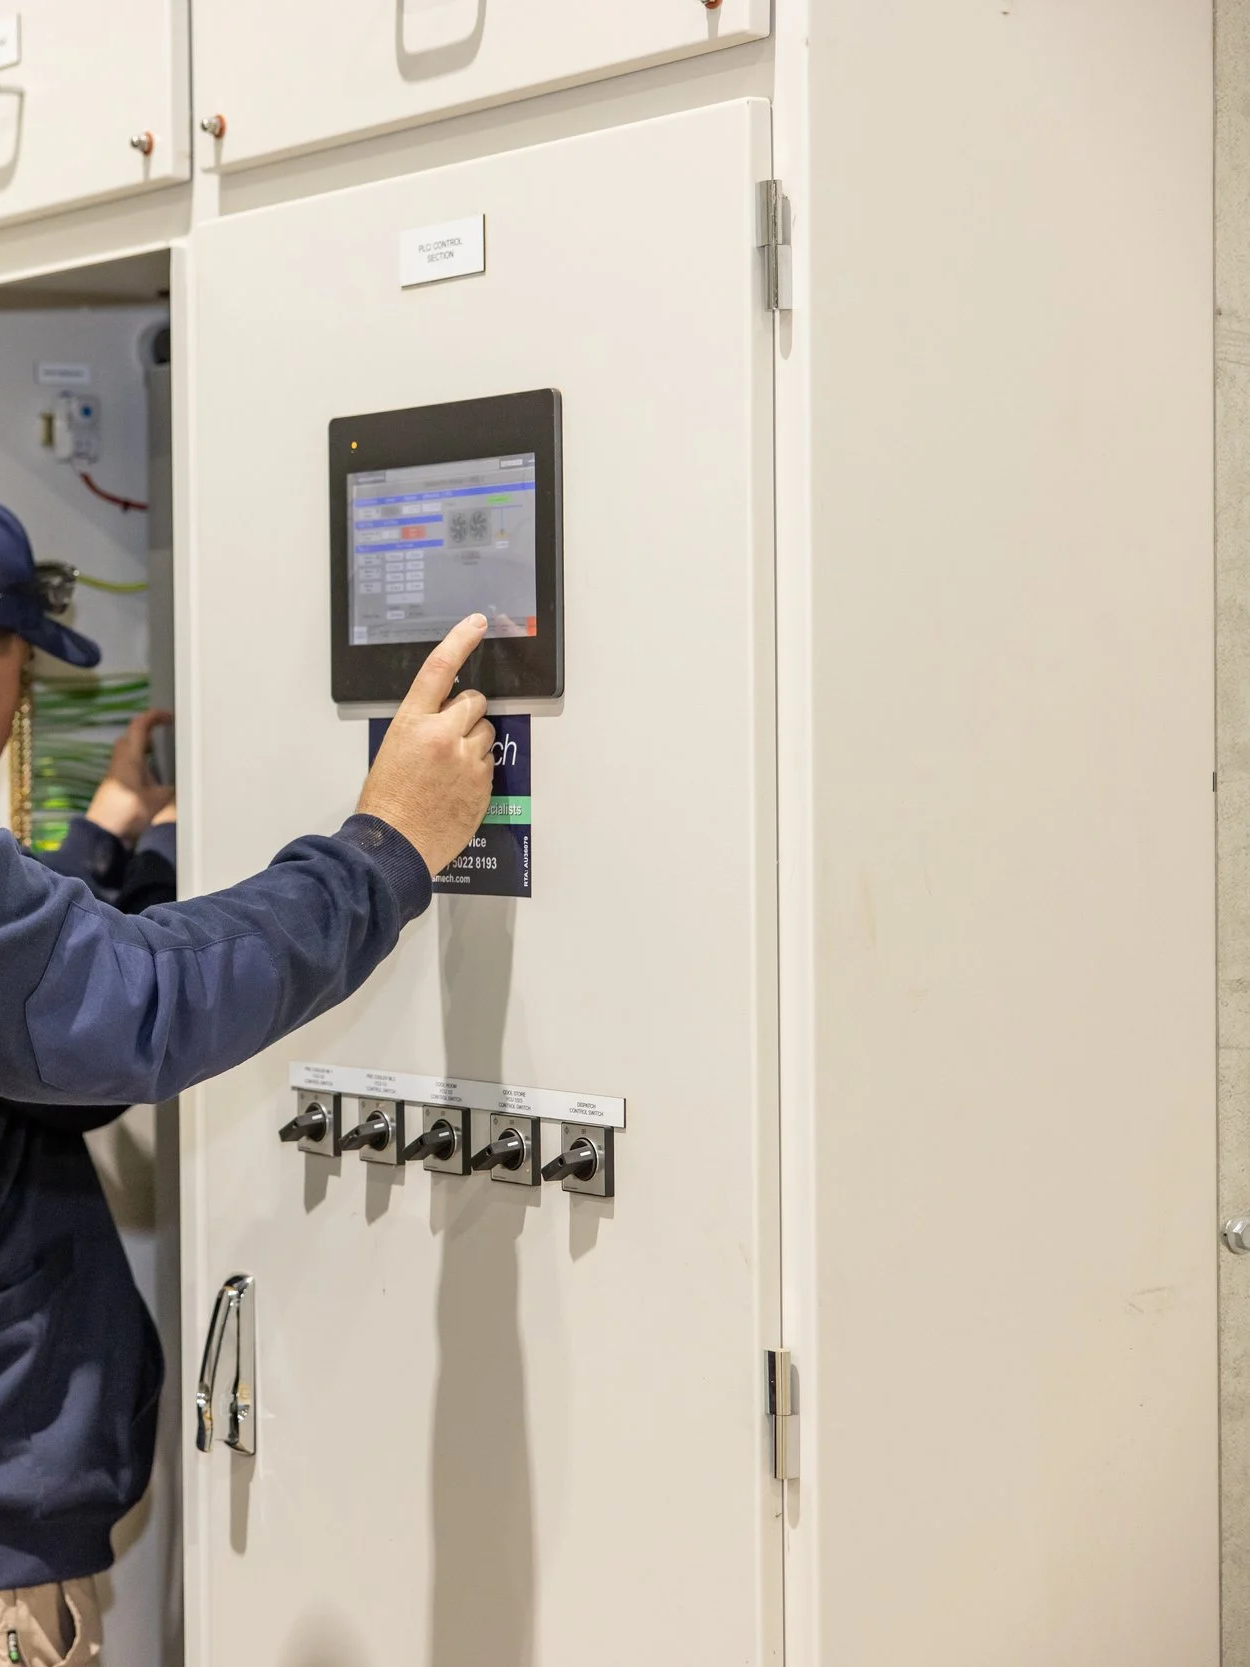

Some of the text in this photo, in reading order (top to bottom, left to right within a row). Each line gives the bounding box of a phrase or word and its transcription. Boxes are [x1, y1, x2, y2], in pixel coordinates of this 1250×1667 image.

[433, 238, 463, 250] CONTROL
[427, 251, 455, 263] SECTION
[487, 803, 523, 816] ecialists
[468, 835, 487, 848] vice
[452, 856, 473, 869] 5022
[475, 856, 497, 870] 8193
